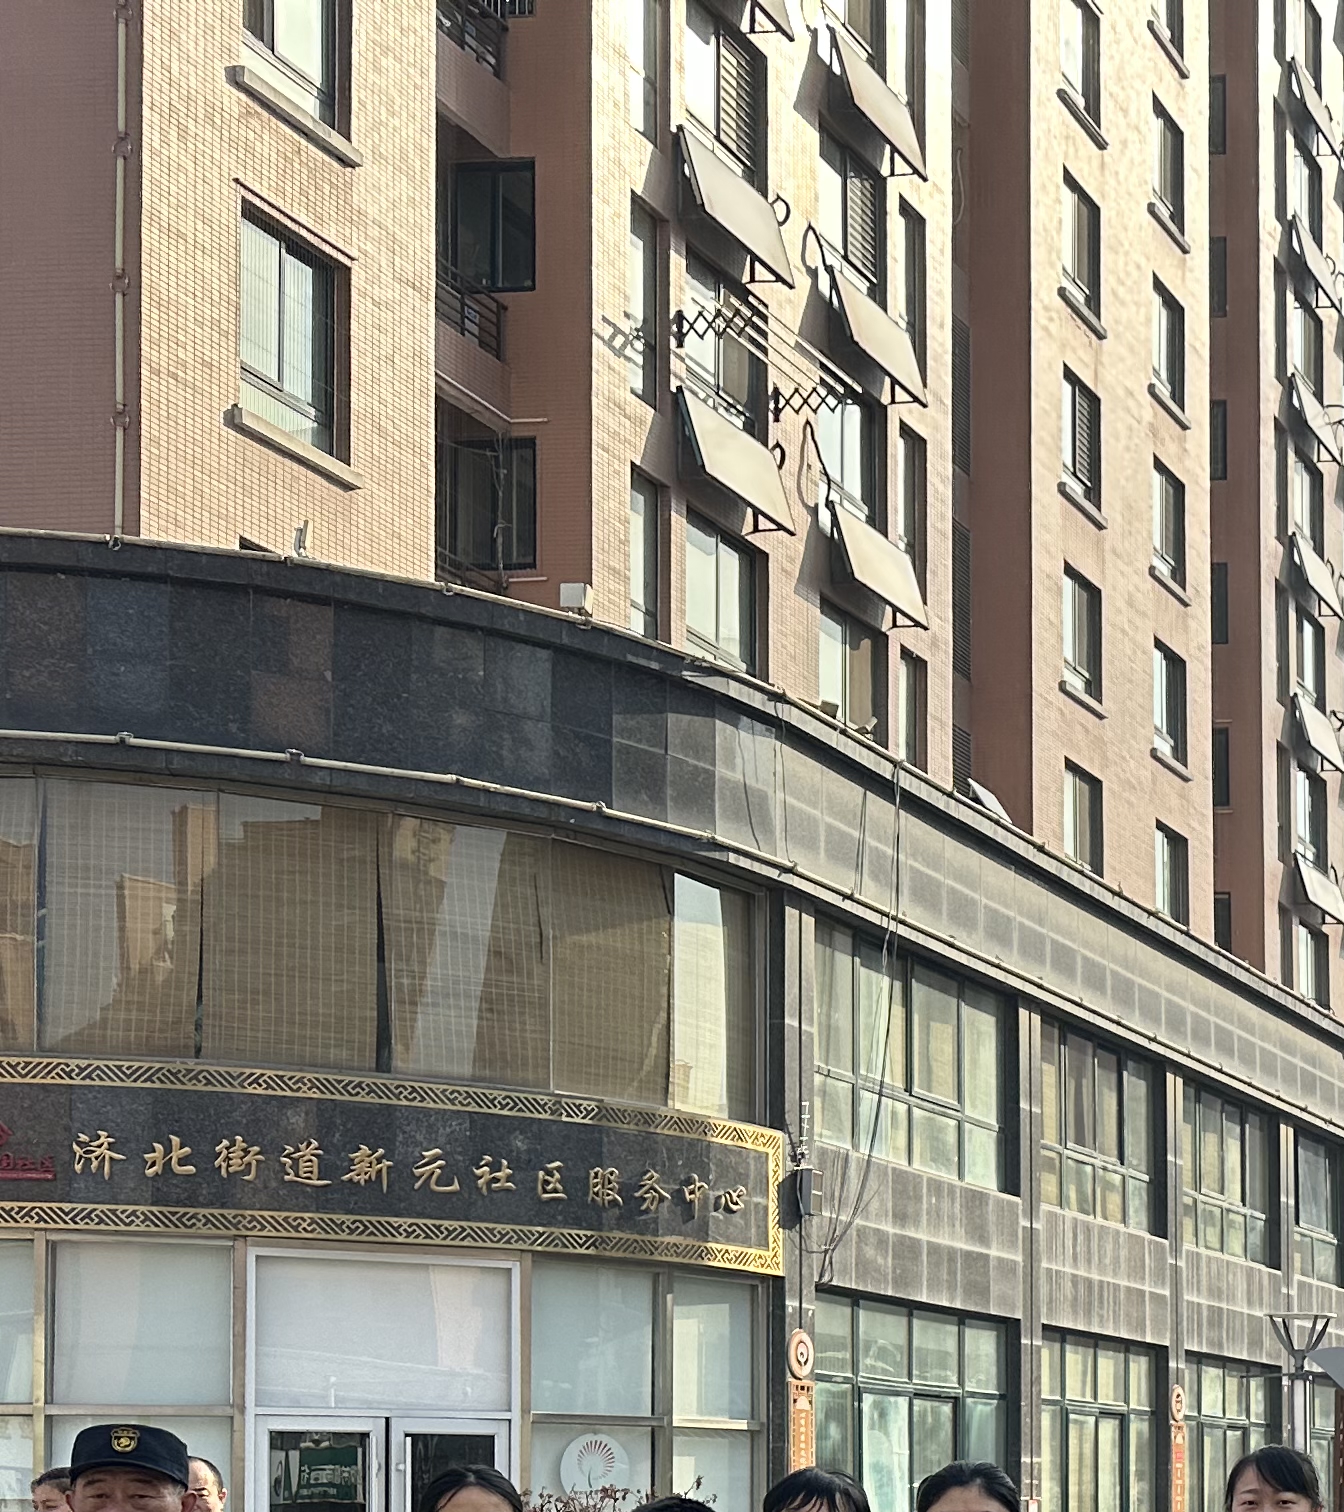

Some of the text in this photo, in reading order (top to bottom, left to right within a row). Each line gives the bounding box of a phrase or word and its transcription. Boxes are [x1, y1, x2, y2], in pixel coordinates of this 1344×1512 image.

[72, 1130, 748, 1215] 济北街道新元社区服务中心
